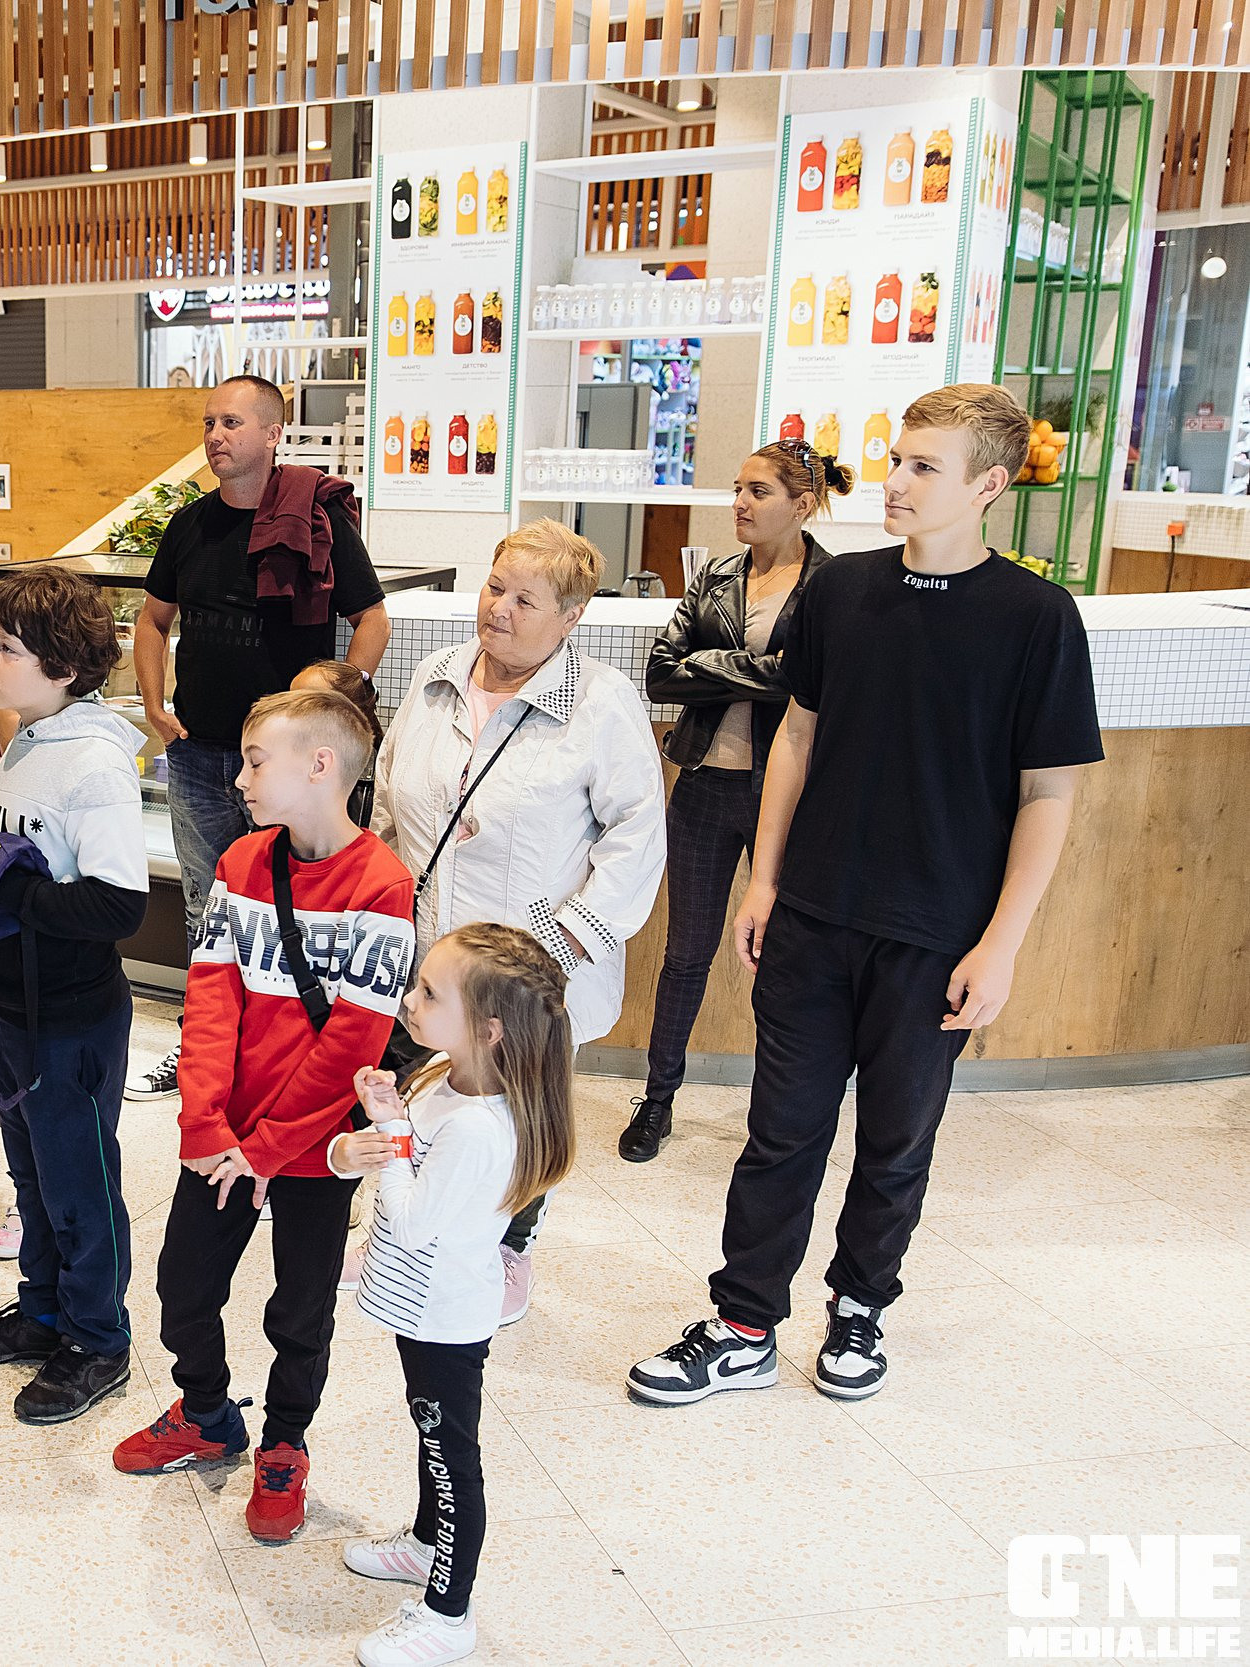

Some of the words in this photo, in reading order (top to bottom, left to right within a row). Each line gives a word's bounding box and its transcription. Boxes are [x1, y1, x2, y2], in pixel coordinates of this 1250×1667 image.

[903, 574, 948, 591] Loyalty
[185, 610, 264, 632] ARMANI
[430, 1516, 456, 1596] FOREVER
